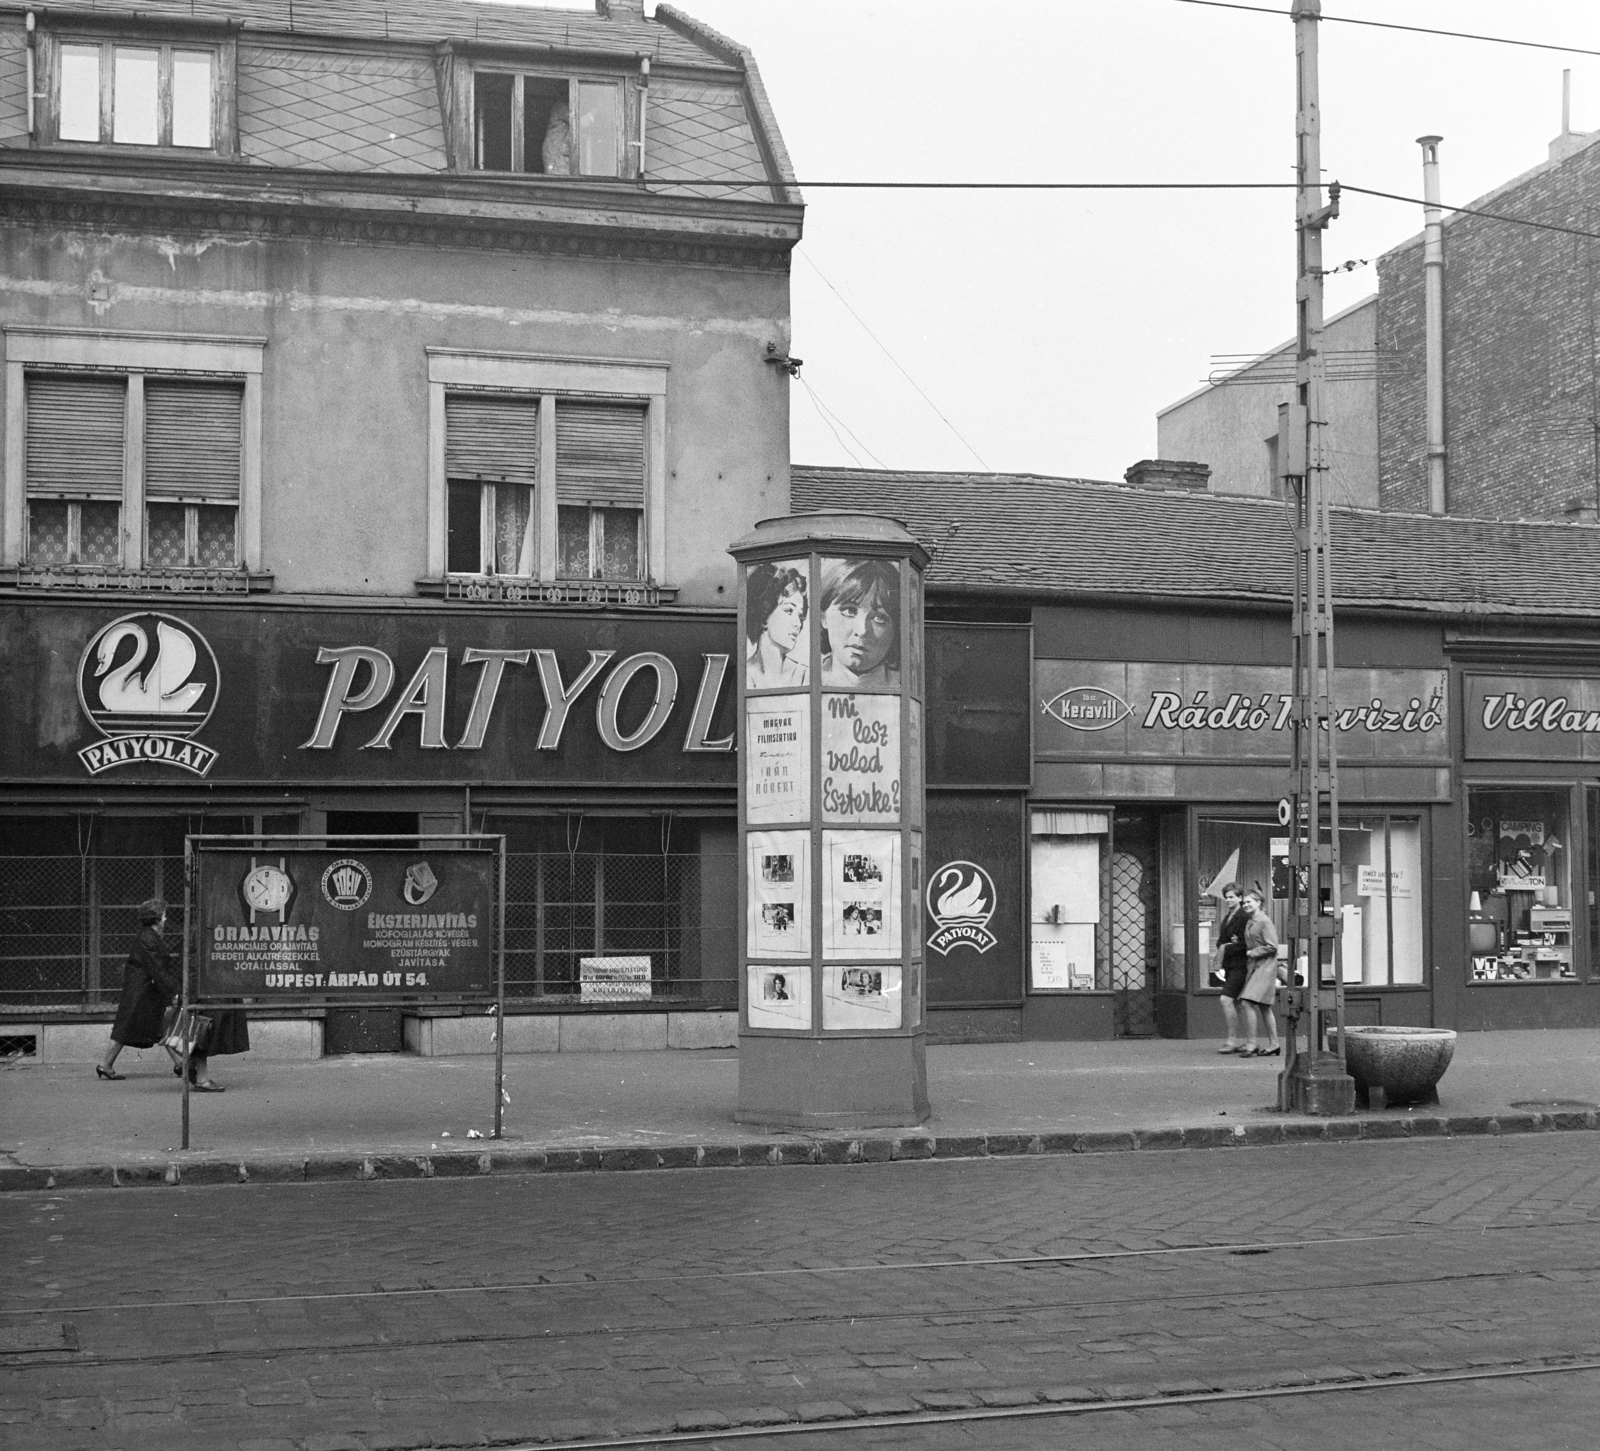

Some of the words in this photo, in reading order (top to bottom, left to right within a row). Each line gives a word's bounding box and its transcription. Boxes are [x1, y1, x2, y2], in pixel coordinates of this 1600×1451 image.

[1061, 699, 1118, 720] Keravill
[1141, 691, 1271, 731] Rádió
[763, 717, 792, 729] MAGYAR
[853, 717, 888, 747] lesz
[85, 737, 210, 770] PATYOLAT
[827, 745, 884, 774] veled
[755, 778, 795, 795] RÓBERT
[823, 776, 900, 815] Eszterke?
[1501, 821, 1542, 833] CAMPING
[367, 912, 477, 929] ÉKSZERJAVÍTÁS
[214, 924, 320, 941] ÓRAJAVÍTÁS
[936, 927, 989, 947] PATYOLAT
[214, 941, 267, 951] GARANCIÁLIS
[269, 941, 318, 951] ÓRAJAVÍTÁS
[363, 939, 413, 948] MONOGRAM
[211, 952, 245, 961] EREDETI
[246, 951, 321, 961] ALKATRÉSZEKKEL
[328, 970, 379, 987] ÁRPÁD
[405, 972, 430, 987] 54.
